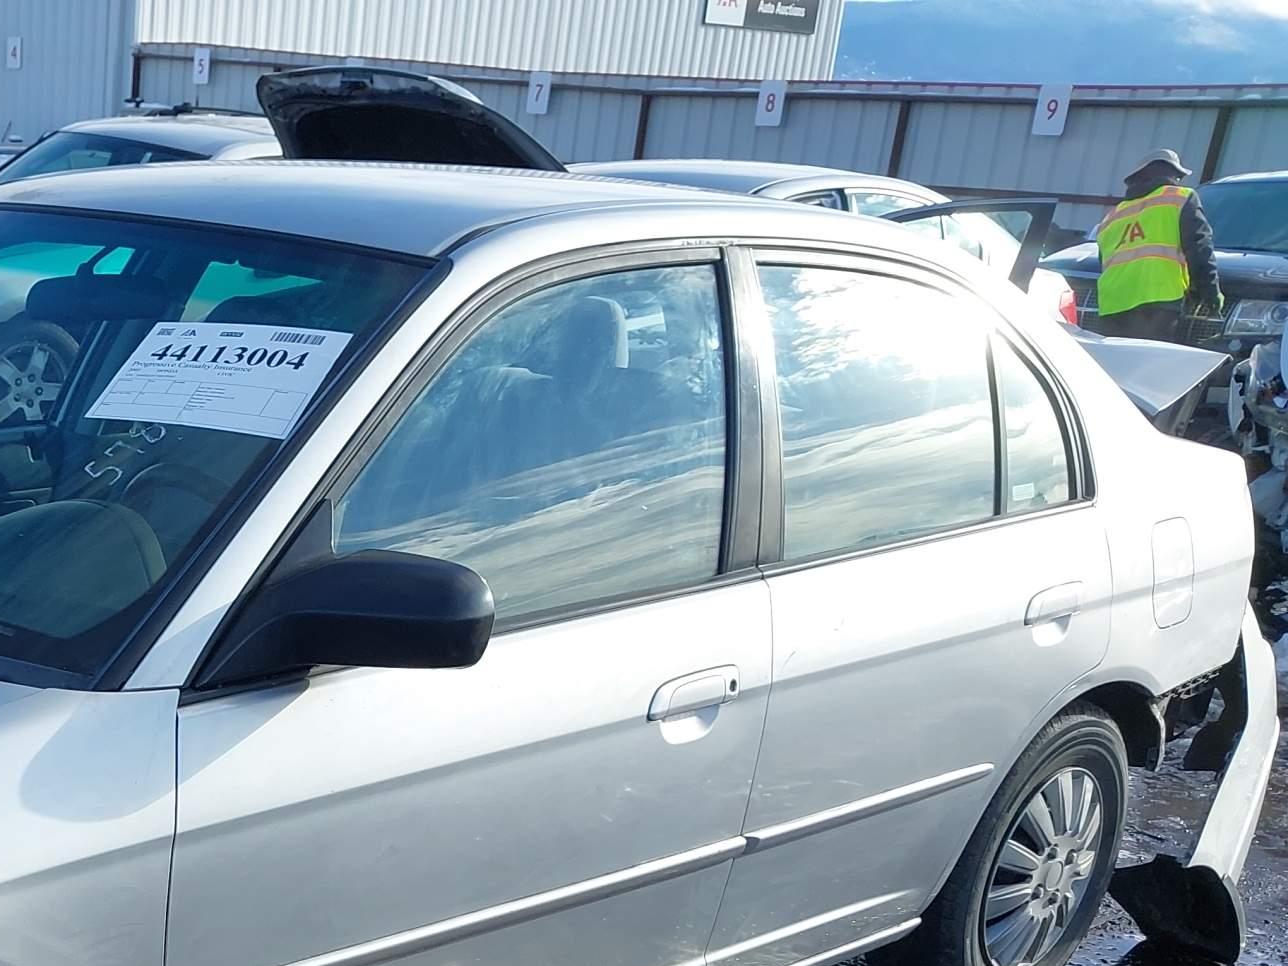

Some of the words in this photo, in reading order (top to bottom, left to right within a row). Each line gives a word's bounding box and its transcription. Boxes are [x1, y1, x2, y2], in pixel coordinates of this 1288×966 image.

[198, 58, 204, 74] 5
[535, 83, 544, 102] 7
[765, 93, 776, 113] 8
[1047, 99, 1058, 120] 9
[150, 343, 310, 371] 44113004
[213, 363, 252, 373] Insurance
